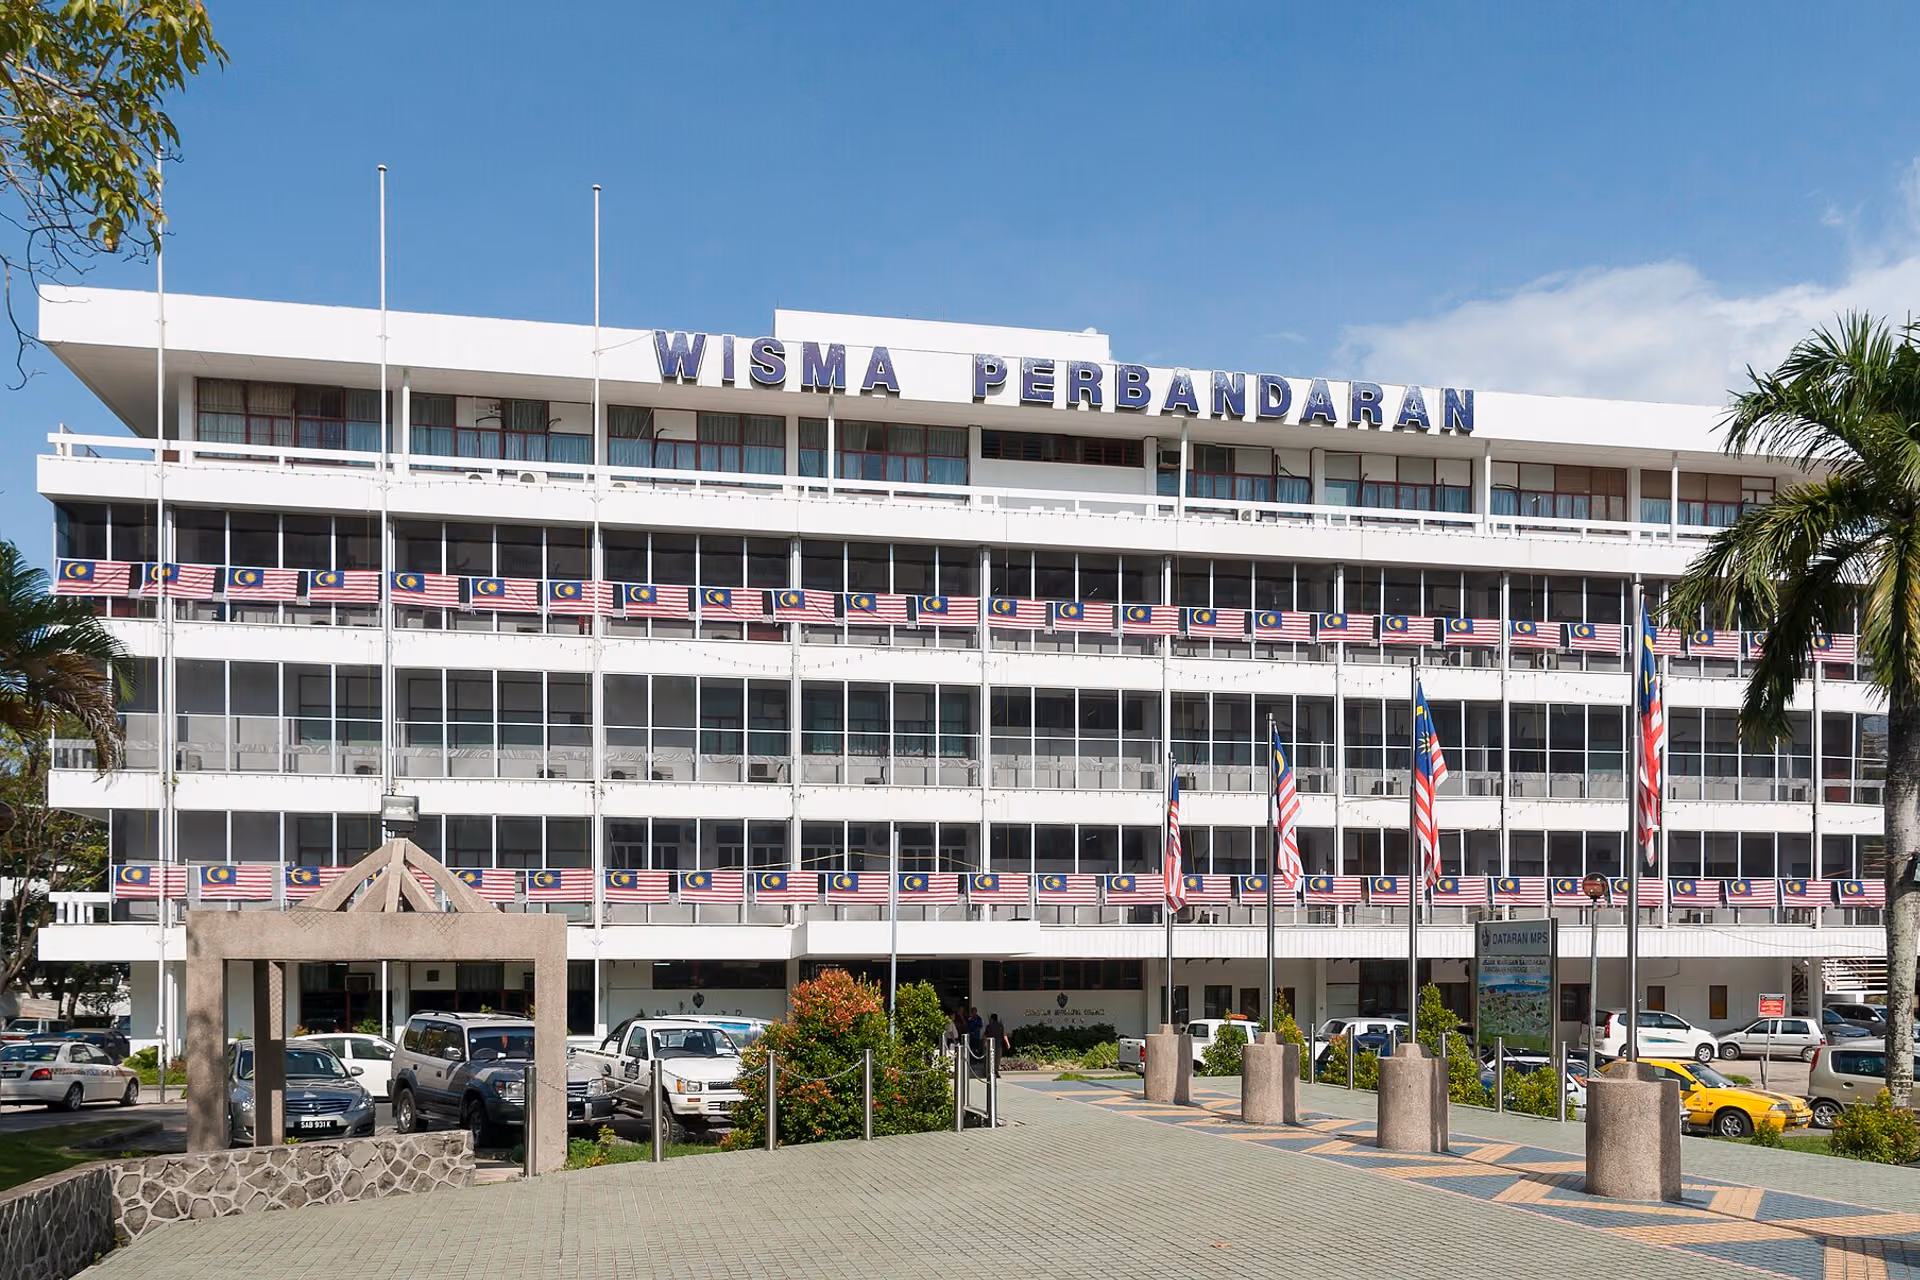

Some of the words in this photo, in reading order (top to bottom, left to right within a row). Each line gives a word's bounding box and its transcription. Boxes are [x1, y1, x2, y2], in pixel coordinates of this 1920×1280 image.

[653, 329, 900, 392] WISMA
[973, 353, 1475, 432] PERBANDARAN
[1492, 931, 1528, 945] DATARAN
[1530, 931, 1548, 944] MPS
